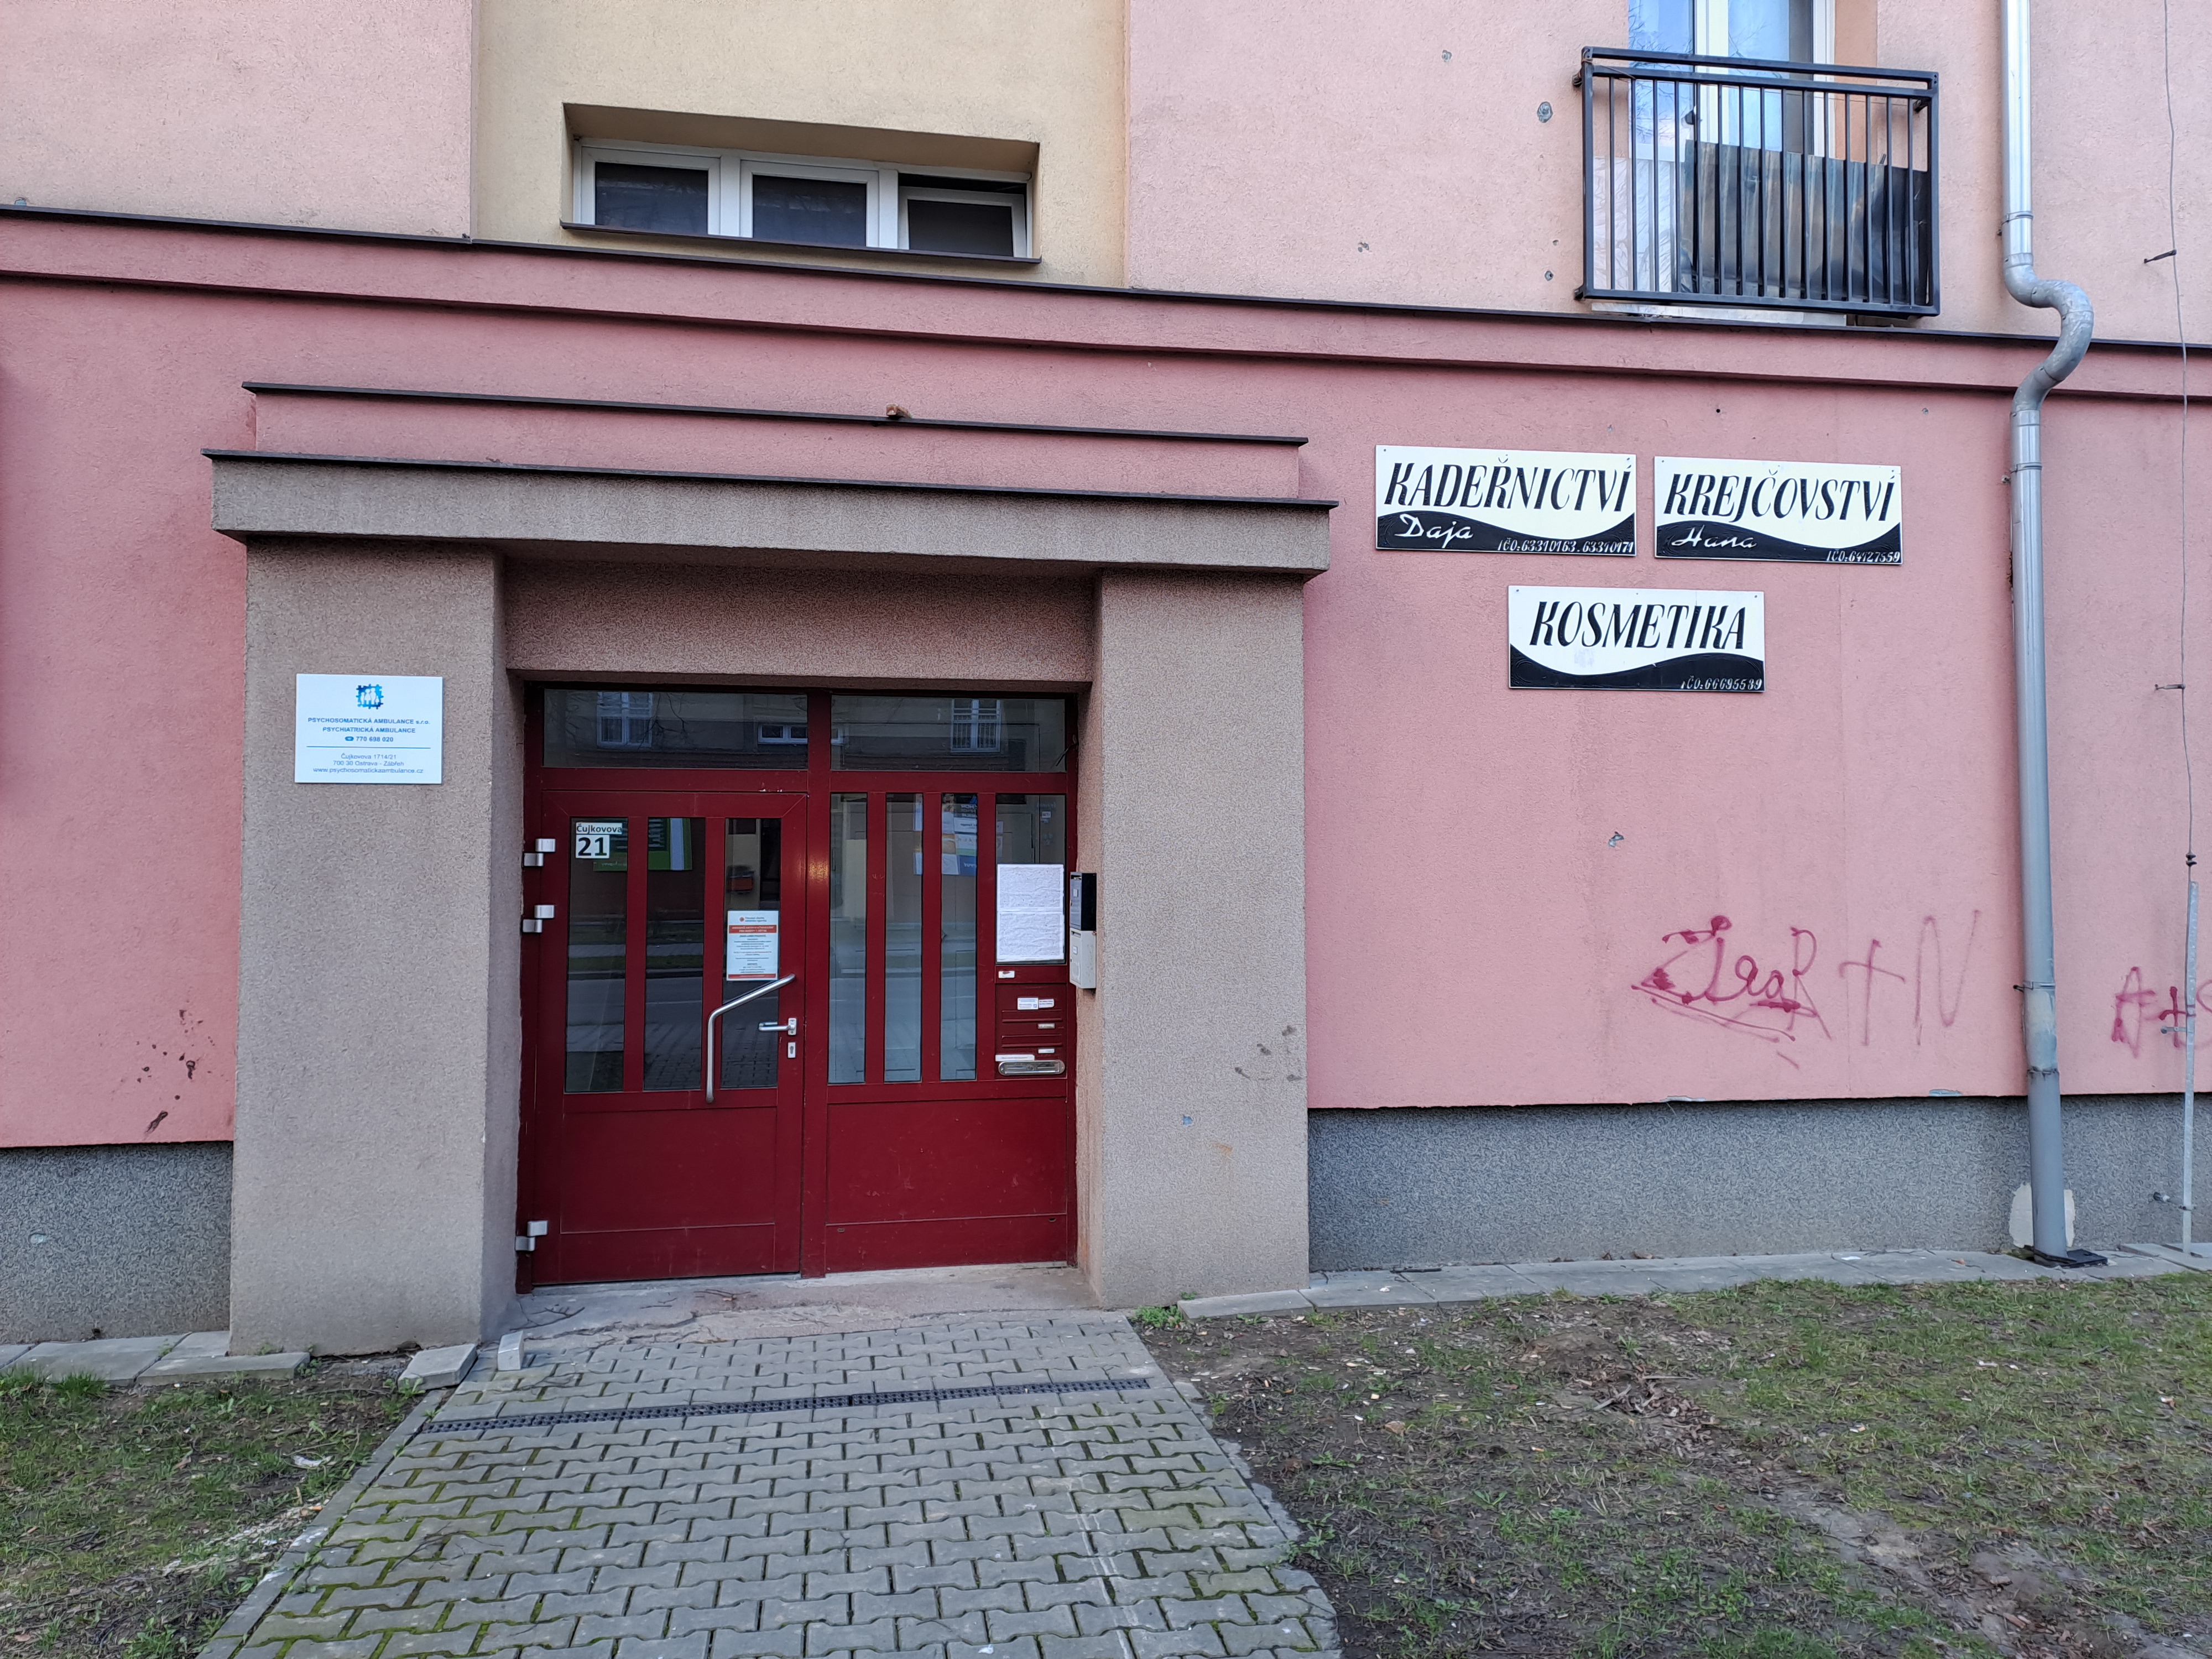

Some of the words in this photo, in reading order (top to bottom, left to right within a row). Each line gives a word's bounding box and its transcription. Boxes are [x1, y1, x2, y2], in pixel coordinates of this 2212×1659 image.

[1384, 453, 1632, 512] KADEŘNICTVÍ
[1663, 465, 1896, 523] KREJČOVSTVÍ
[1394, 513, 1474, 549] Daja
[1671, 523, 1757, 549] Hana
[1528, 601, 1746, 650] KOSMETIKA
[341, 753, 372, 761] Čujkovova
[576, 823, 622, 834] Čujkovova
[577, 837, 608, 857] 21
